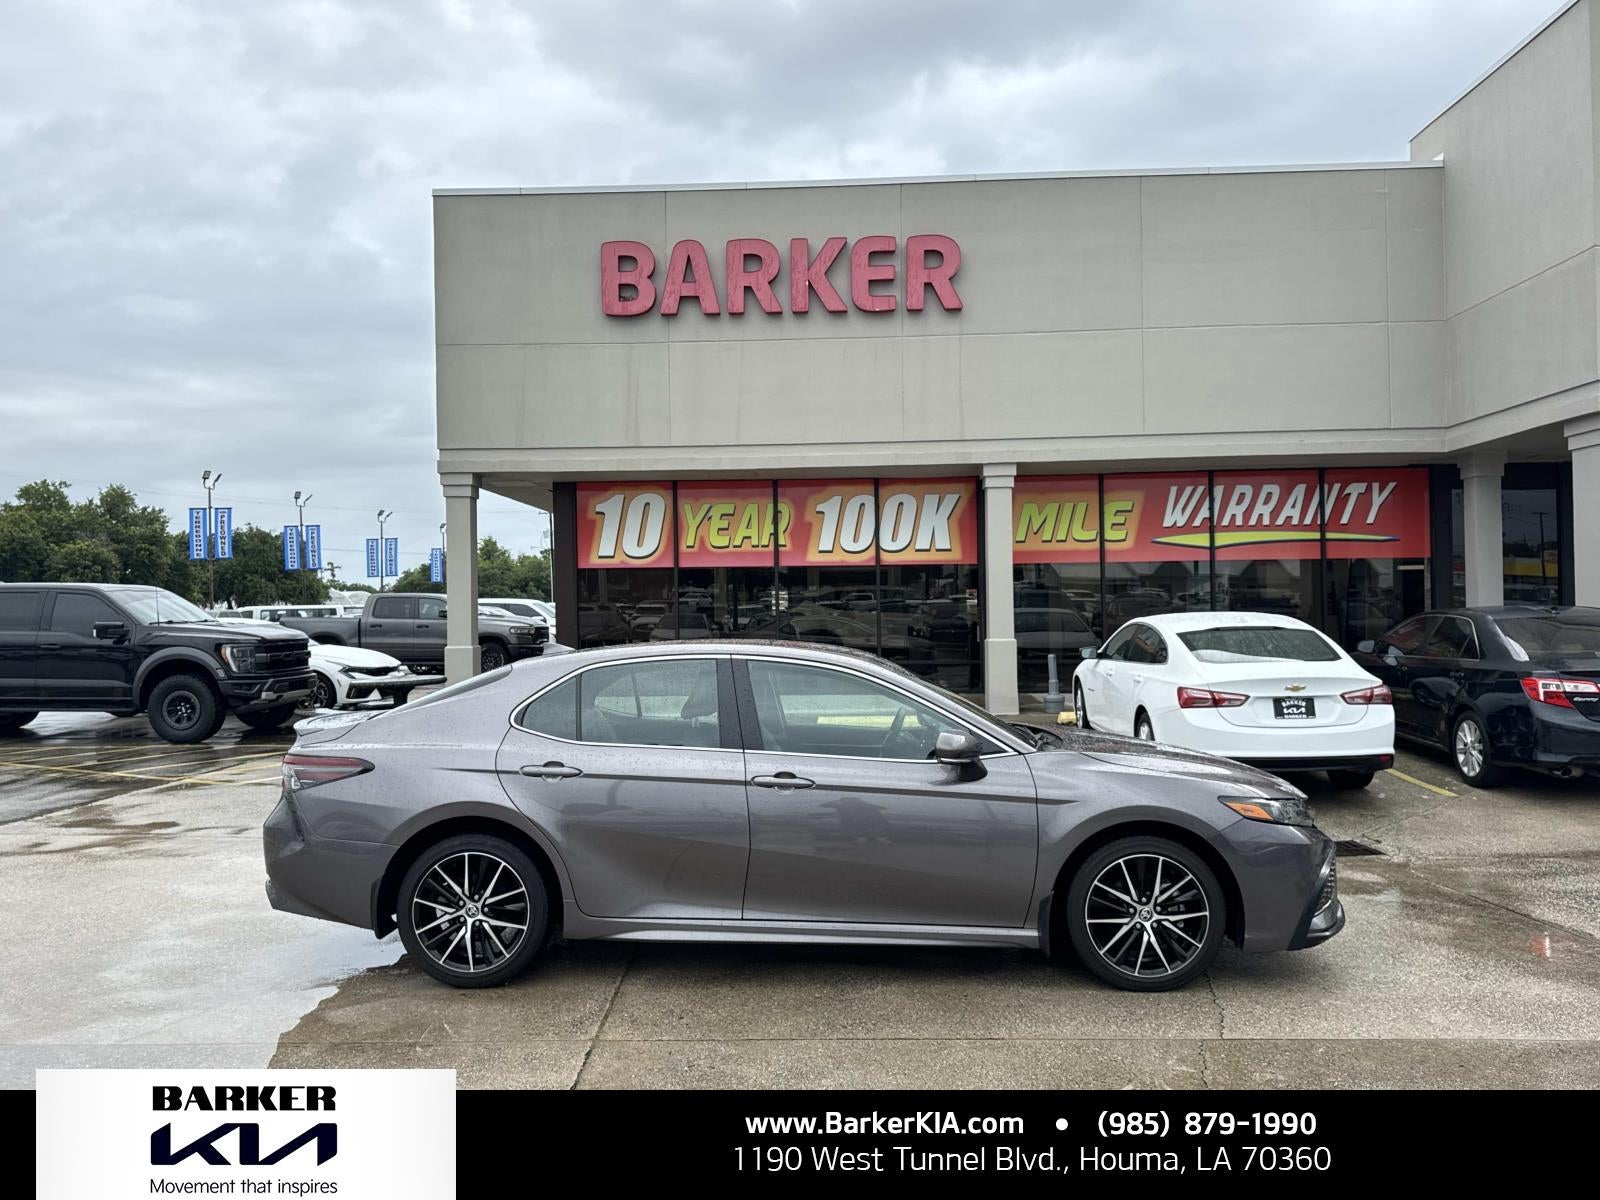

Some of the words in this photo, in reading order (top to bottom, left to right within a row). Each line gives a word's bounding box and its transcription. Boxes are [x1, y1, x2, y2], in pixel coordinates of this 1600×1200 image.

[601, 234, 964, 317] BARKER
[595, 492, 666, 560] 10
[683, 502, 791, 549] YEAR
[816, 493, 961, 554] 100K
[1016, 501, 1134, 543] MILE
[1162, 481, 1397, 528] WARRANTY
